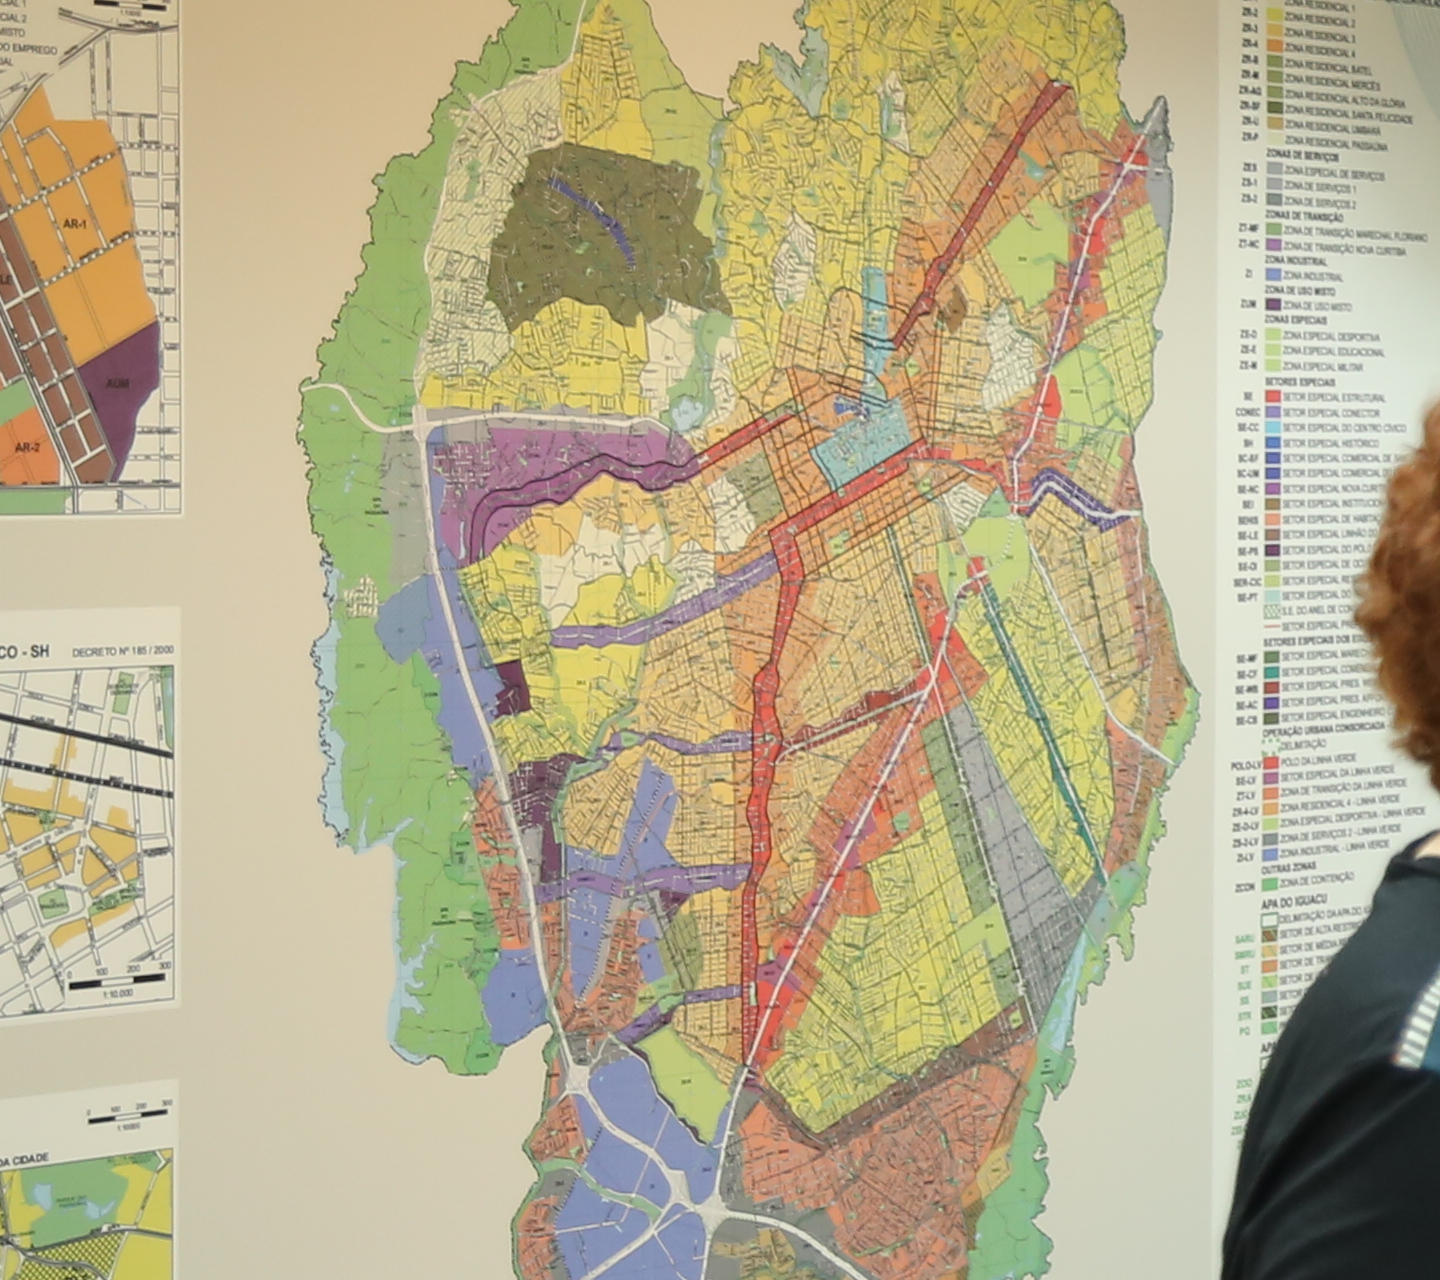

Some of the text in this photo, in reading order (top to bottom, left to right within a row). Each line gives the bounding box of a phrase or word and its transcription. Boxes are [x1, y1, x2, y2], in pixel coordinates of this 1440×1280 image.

[63, 219, 87, 230] AR-1
[15, 442, 40, 453] AR-2
[30, 644, 50, 658] SH
[72, 647, 118, 658] DECRETO
[132, 646, 147, 655] 185
[154, 645, 175, 655] 2000
[1261, 899, 1278, 910] APA
[1280, 897, 1293, 908] DO
[13, 1152, 50, 1166] CIDADE
